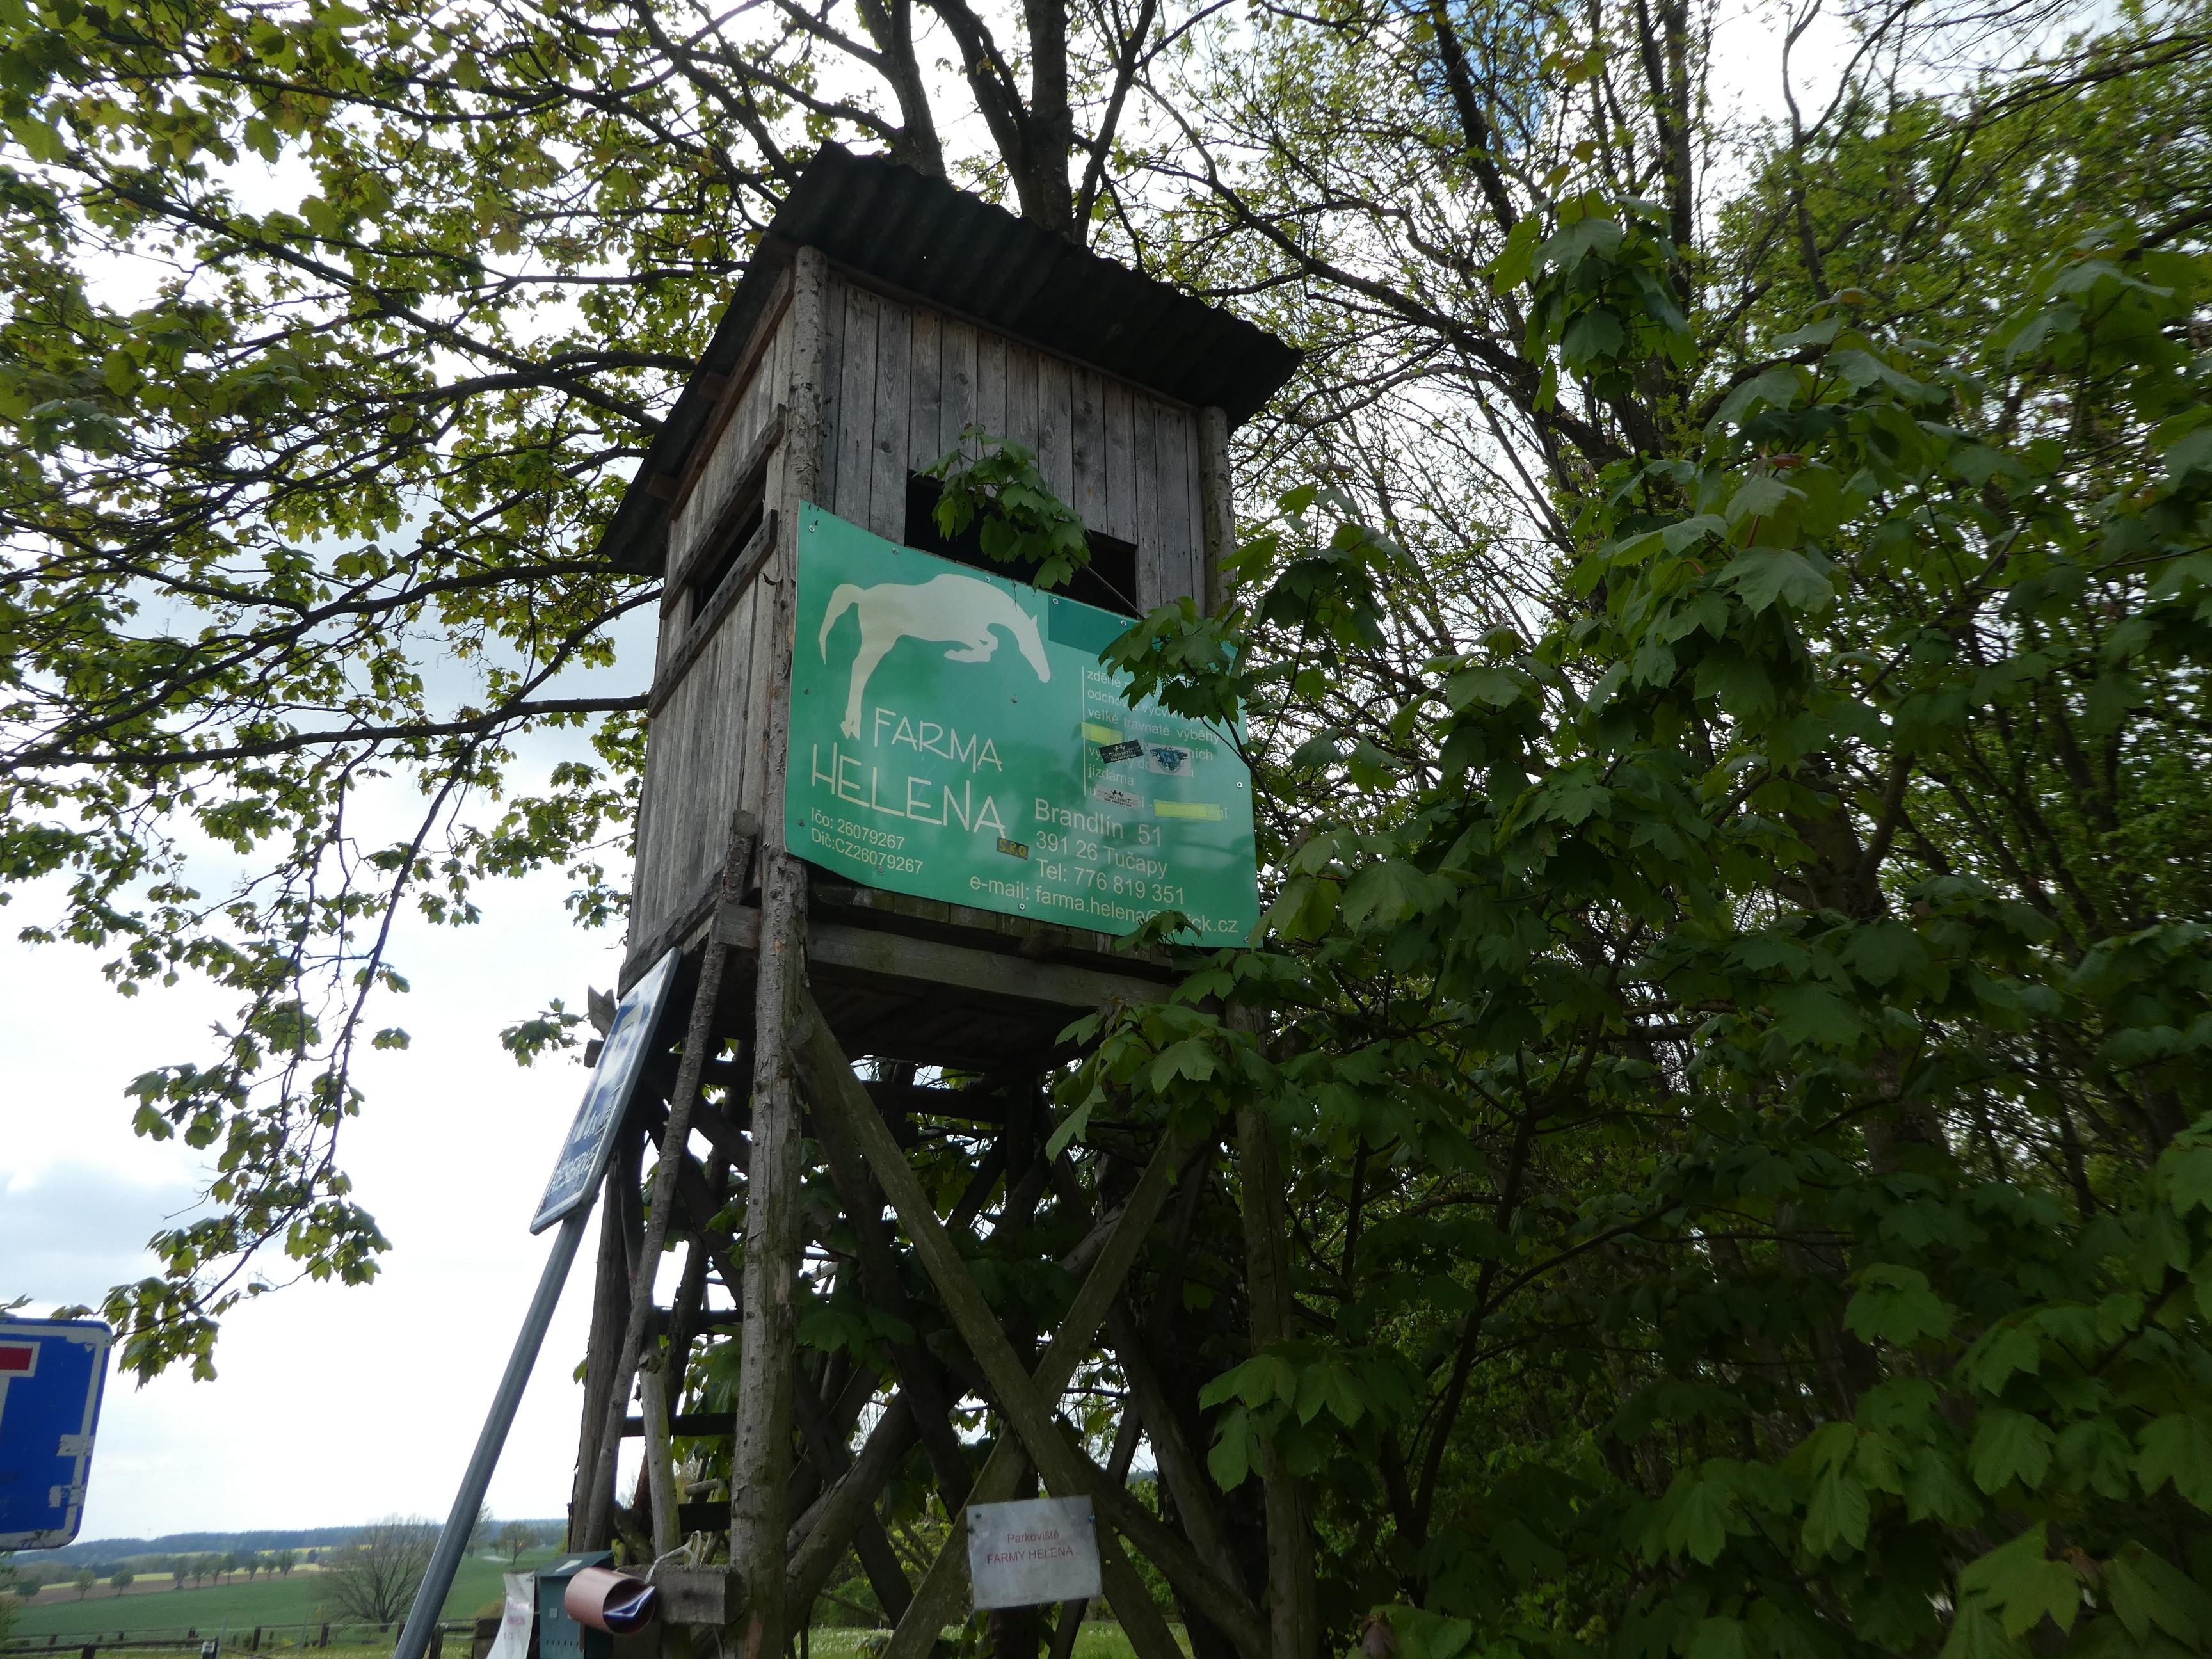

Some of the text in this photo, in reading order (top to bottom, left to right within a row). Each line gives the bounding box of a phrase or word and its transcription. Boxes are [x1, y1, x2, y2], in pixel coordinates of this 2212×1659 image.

[874, 707, 1002, 773] FARMA
[1088, 708, 1119, 724] velké
[1124, 716, 1170, 736] travnaté
[1176, 728, 1220, 745] výběhy
[811, 742, 1006, 838] HELENA
[1088, 764, 1134, 786] jízdárna
[812, 807, 905, 850] Ičo: 26079267
[1034, 797, 1124, 840] Brandlín
[1137, 823, 1161, 847] 51
[811, 827, 924, 874] Dič:CZ26079267
[1036, 830, 1168, 879] 391 26 Tučapy
[970, 876, 1029, 901] e-mail:
[1036, 858, 1183, 905] Tel: 776 819 351
[987, 1546, 1074, 1565] FARMY HELENA
